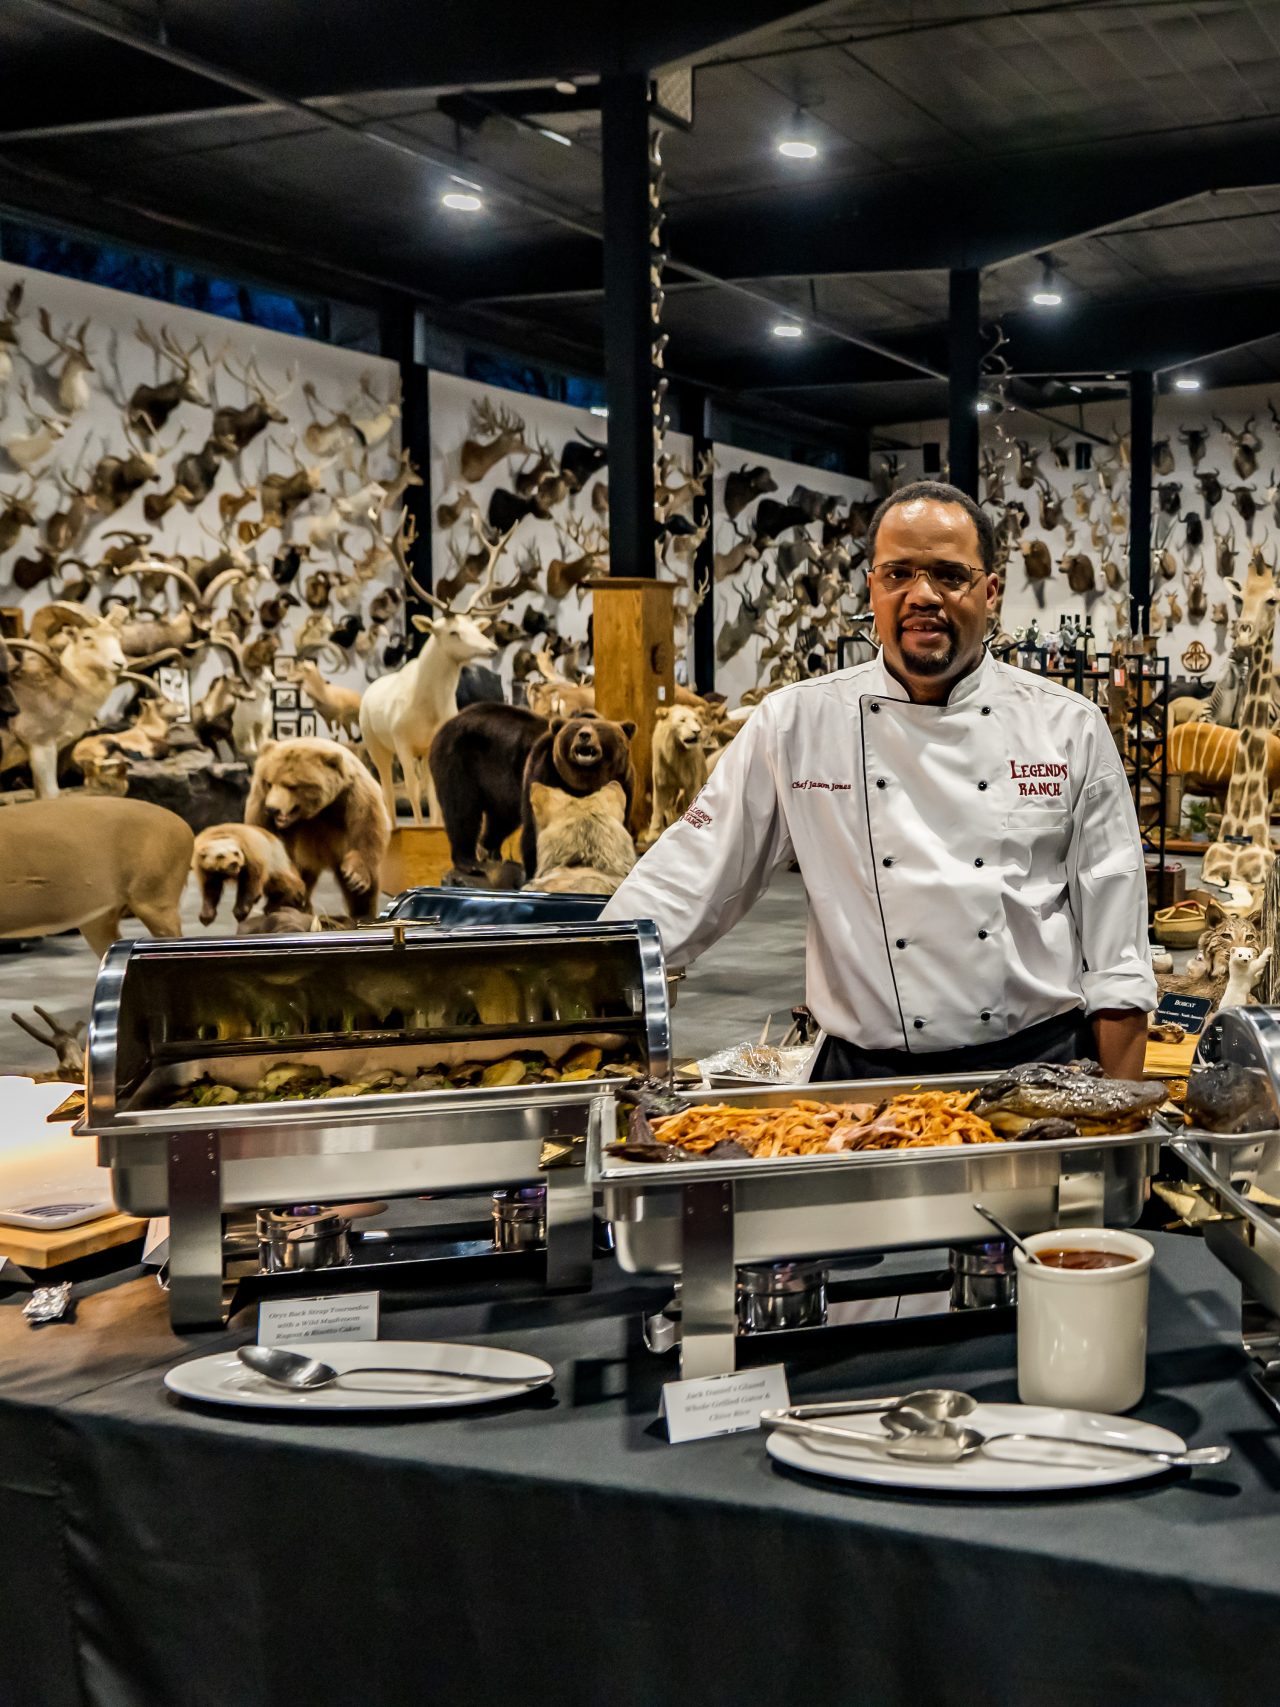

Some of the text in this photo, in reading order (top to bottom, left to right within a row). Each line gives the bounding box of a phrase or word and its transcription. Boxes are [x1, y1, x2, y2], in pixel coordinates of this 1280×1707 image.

[1010, 760, 1068, 781] LEGENDS
[792, 780, 852, 792] Chef Jason Jones
[1018, 782, 1063, 797] RANCH
